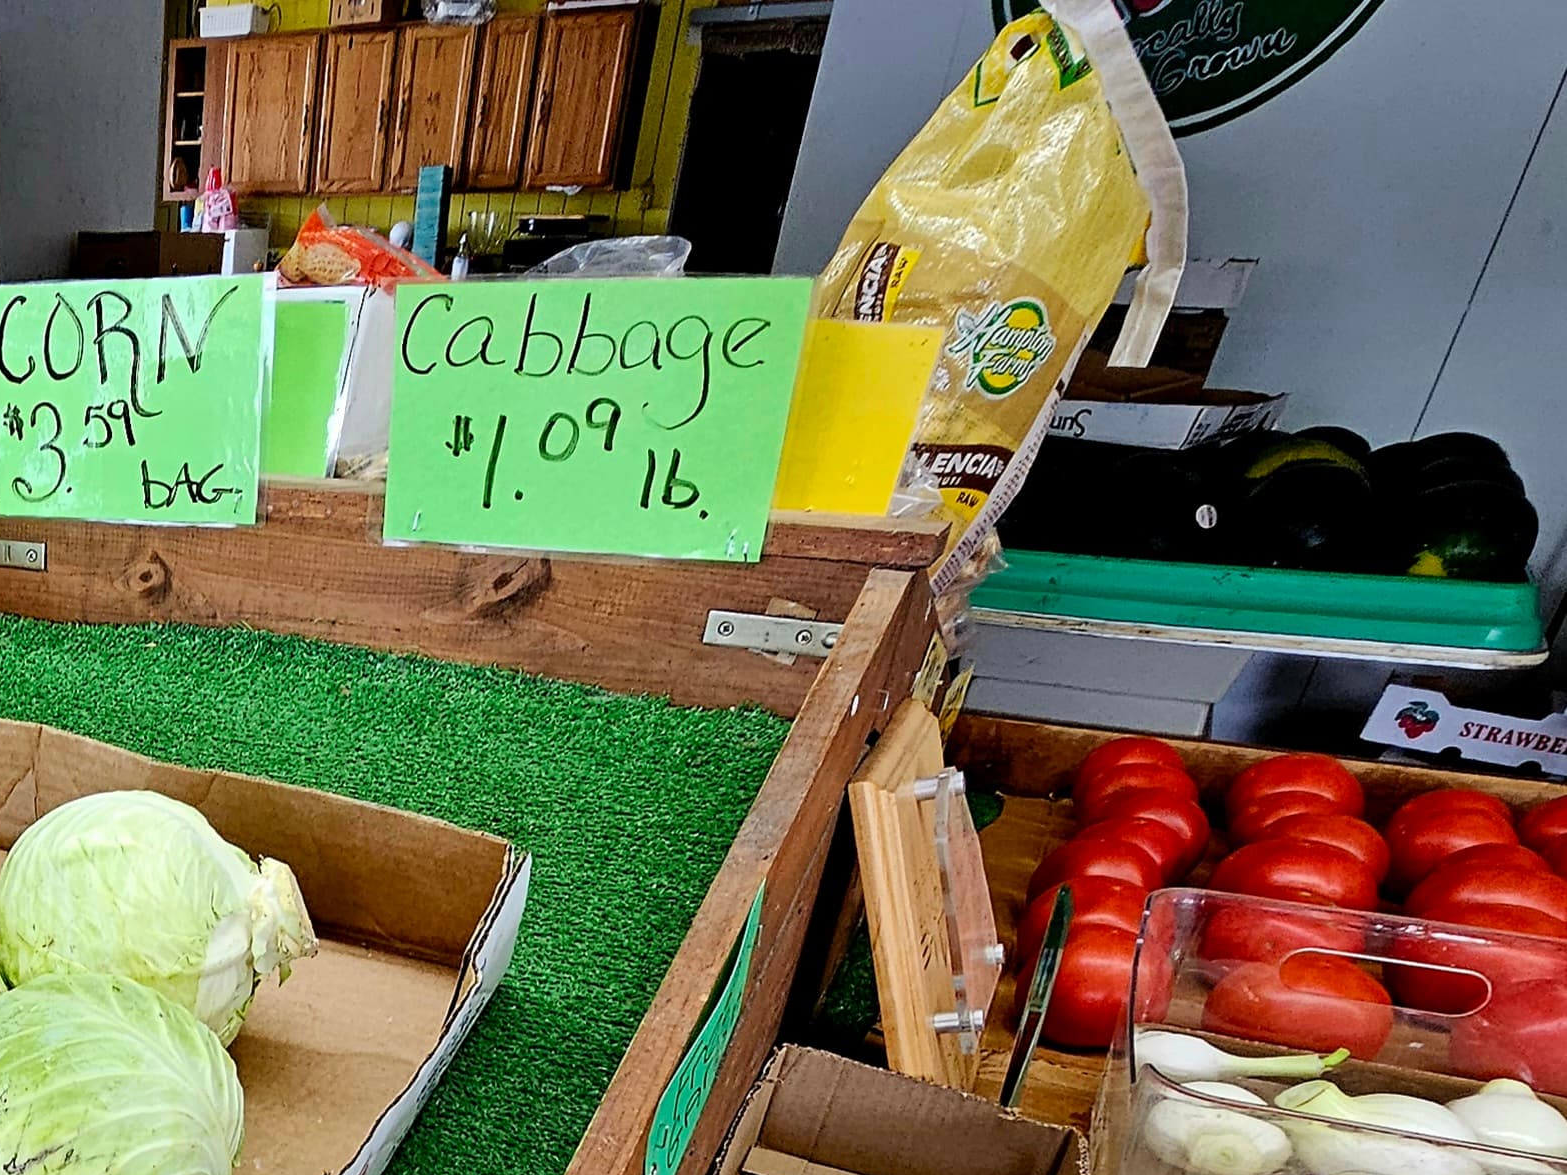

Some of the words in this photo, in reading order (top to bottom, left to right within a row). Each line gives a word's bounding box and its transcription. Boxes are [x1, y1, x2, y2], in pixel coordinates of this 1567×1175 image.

[1133, 0, 1243, 56] cally
[1152, 28, 1297, 96] Grown
[948, 302, 1054, 360] Hampton
[401, 292, 771, 430] Cabbage
[966, 350, 1035, 388] Farms
[956, 491, 979, 507] RAW
[1459, 721, 1567, 756] STRAWBE
